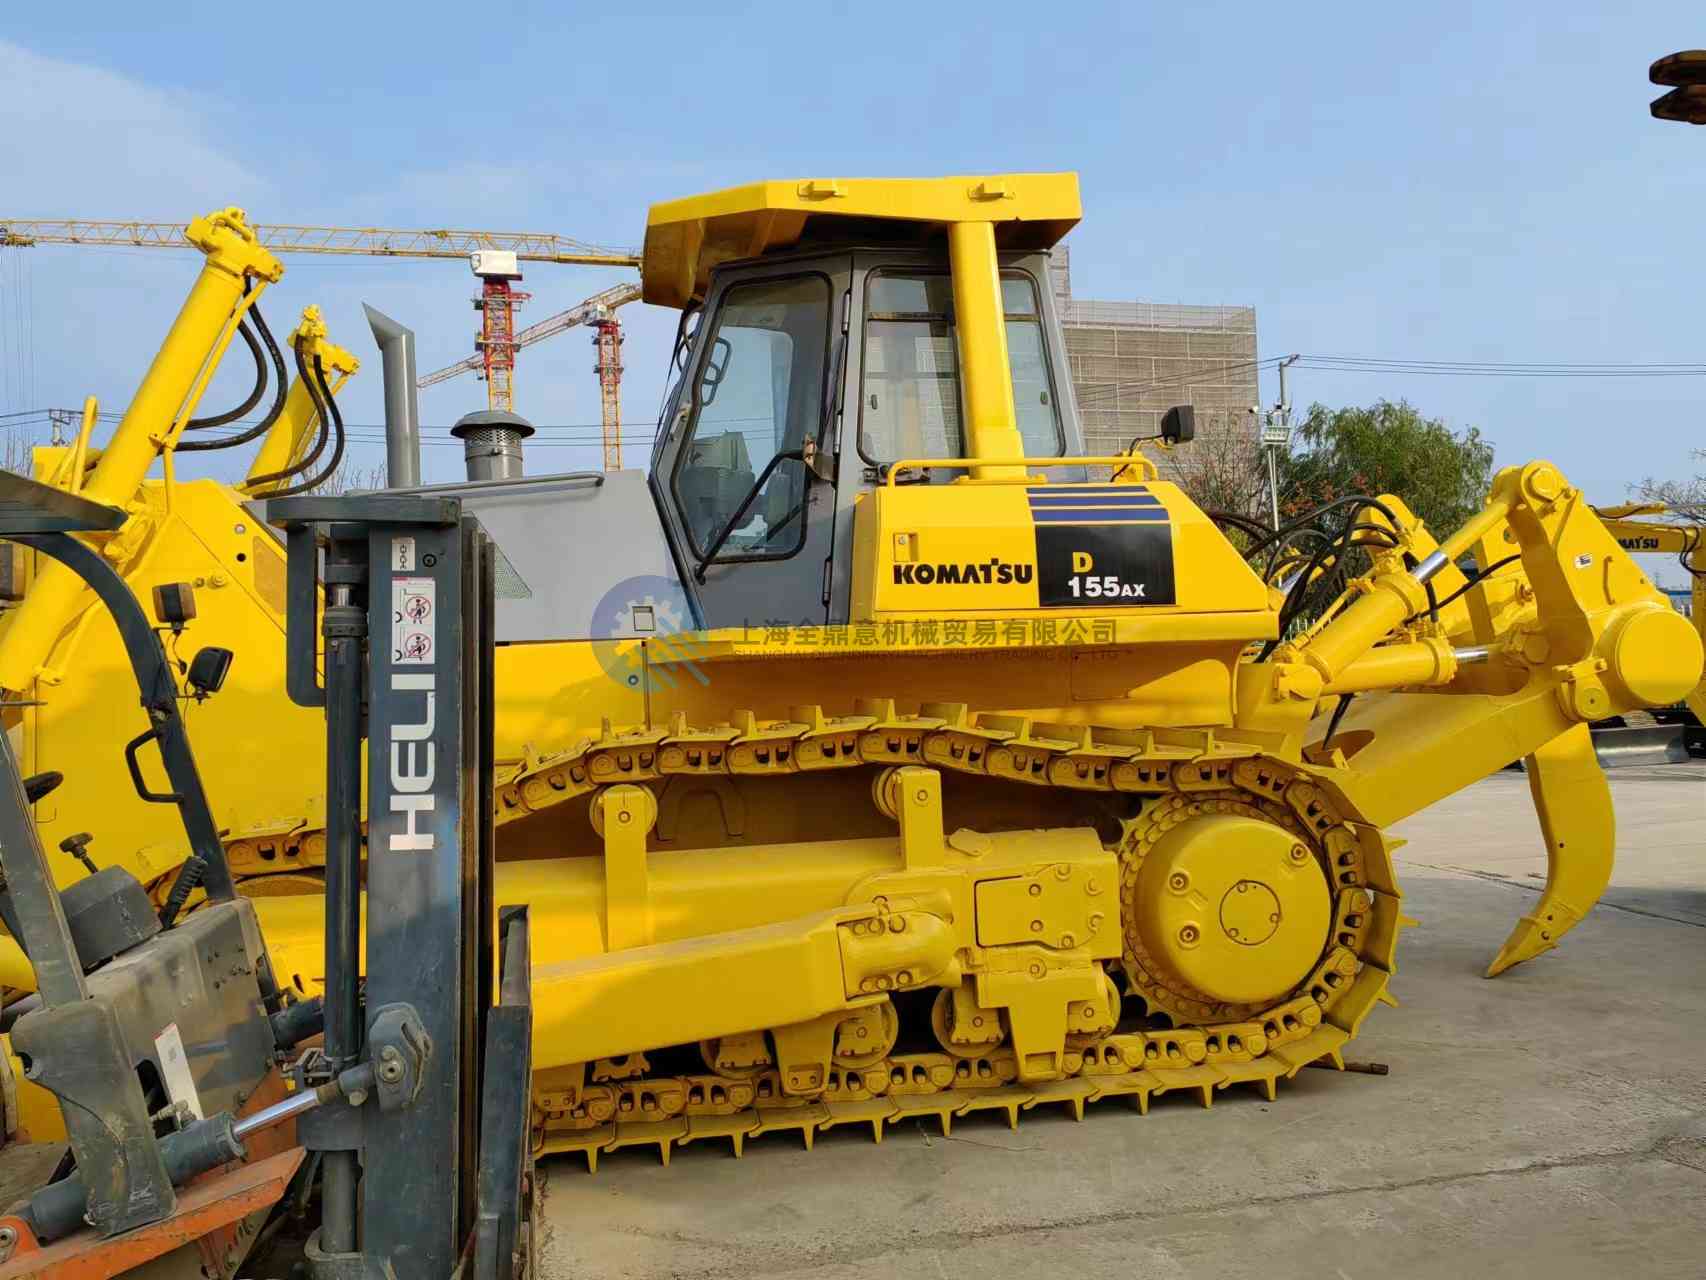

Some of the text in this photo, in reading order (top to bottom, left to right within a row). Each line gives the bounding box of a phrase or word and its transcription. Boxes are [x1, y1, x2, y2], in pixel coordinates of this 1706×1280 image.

[1616, 536, 1659, 549] MATSU
[893, 558, 1032, 584] KOMATSU
[1072, 551, 1093, 573] D
[1068, 576, 1145, 597] 155AX
[390, 674, 435, 850] HELI
